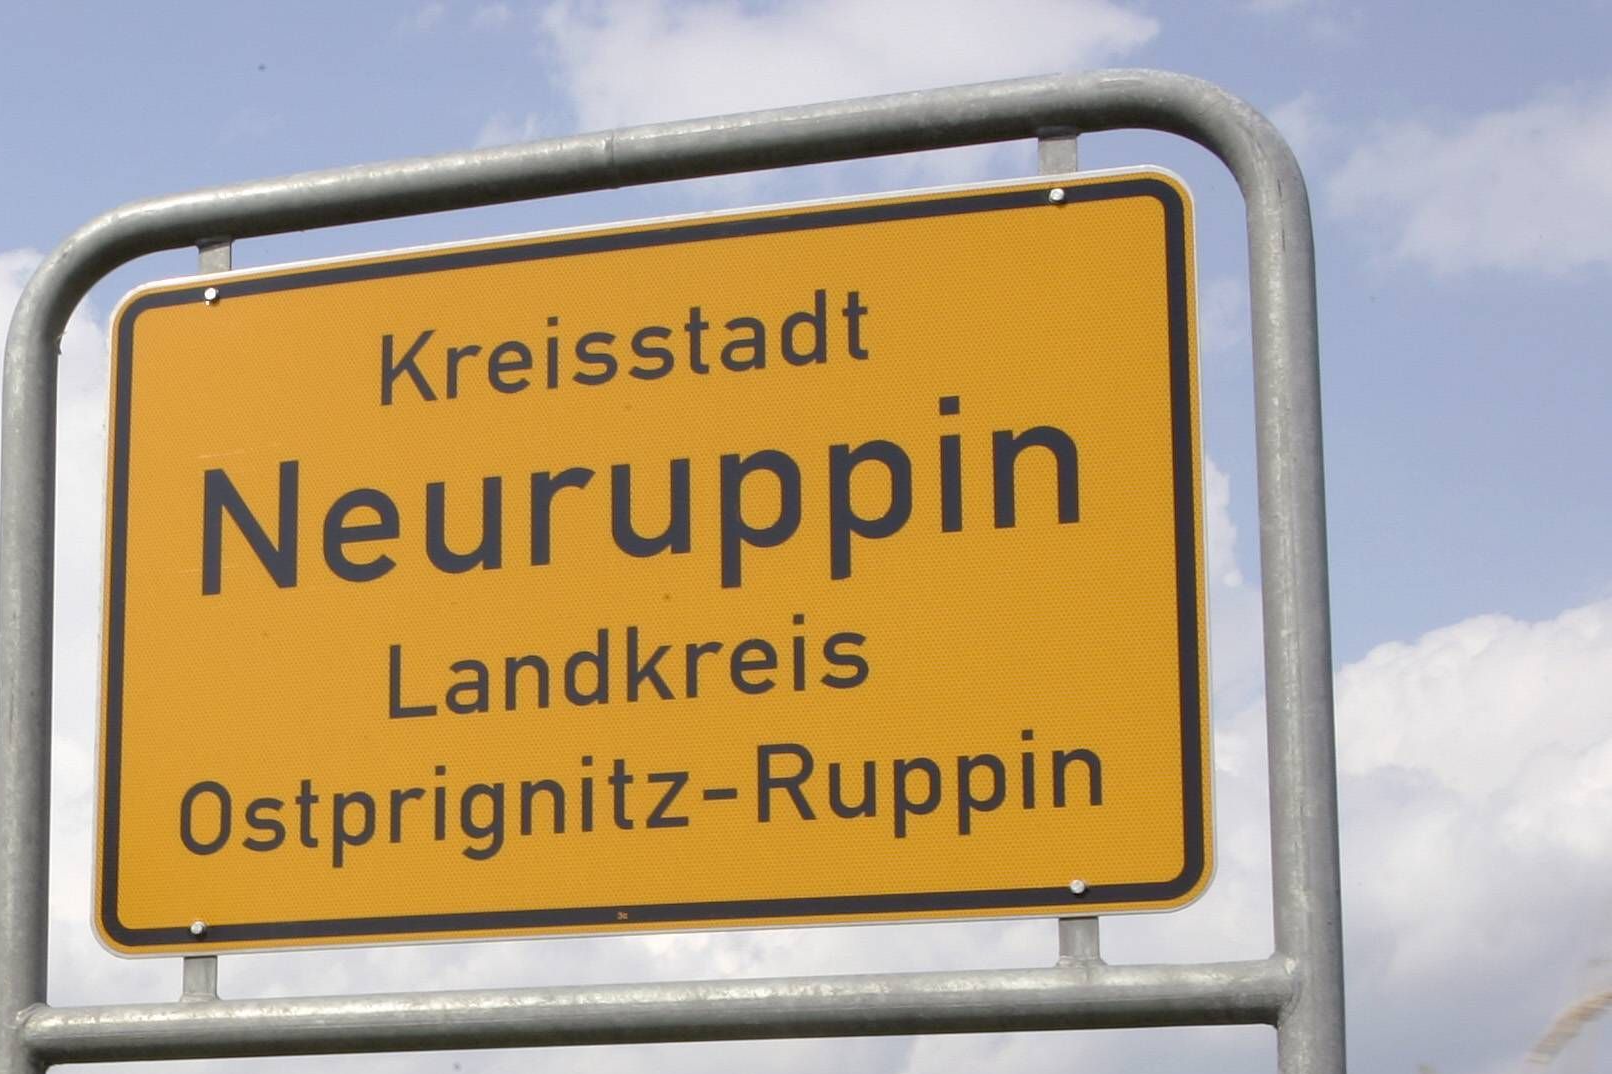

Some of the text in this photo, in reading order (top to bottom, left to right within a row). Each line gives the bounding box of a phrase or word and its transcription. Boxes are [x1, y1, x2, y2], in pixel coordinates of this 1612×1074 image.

[380, 288, 869, 407] Kreisstadt
[201, 395, 1081, 596] Neuruppin
[388, 613, 870, 719] Landkreis
[179, 728, 1103, 869] Ostprignitz-Ruppin
